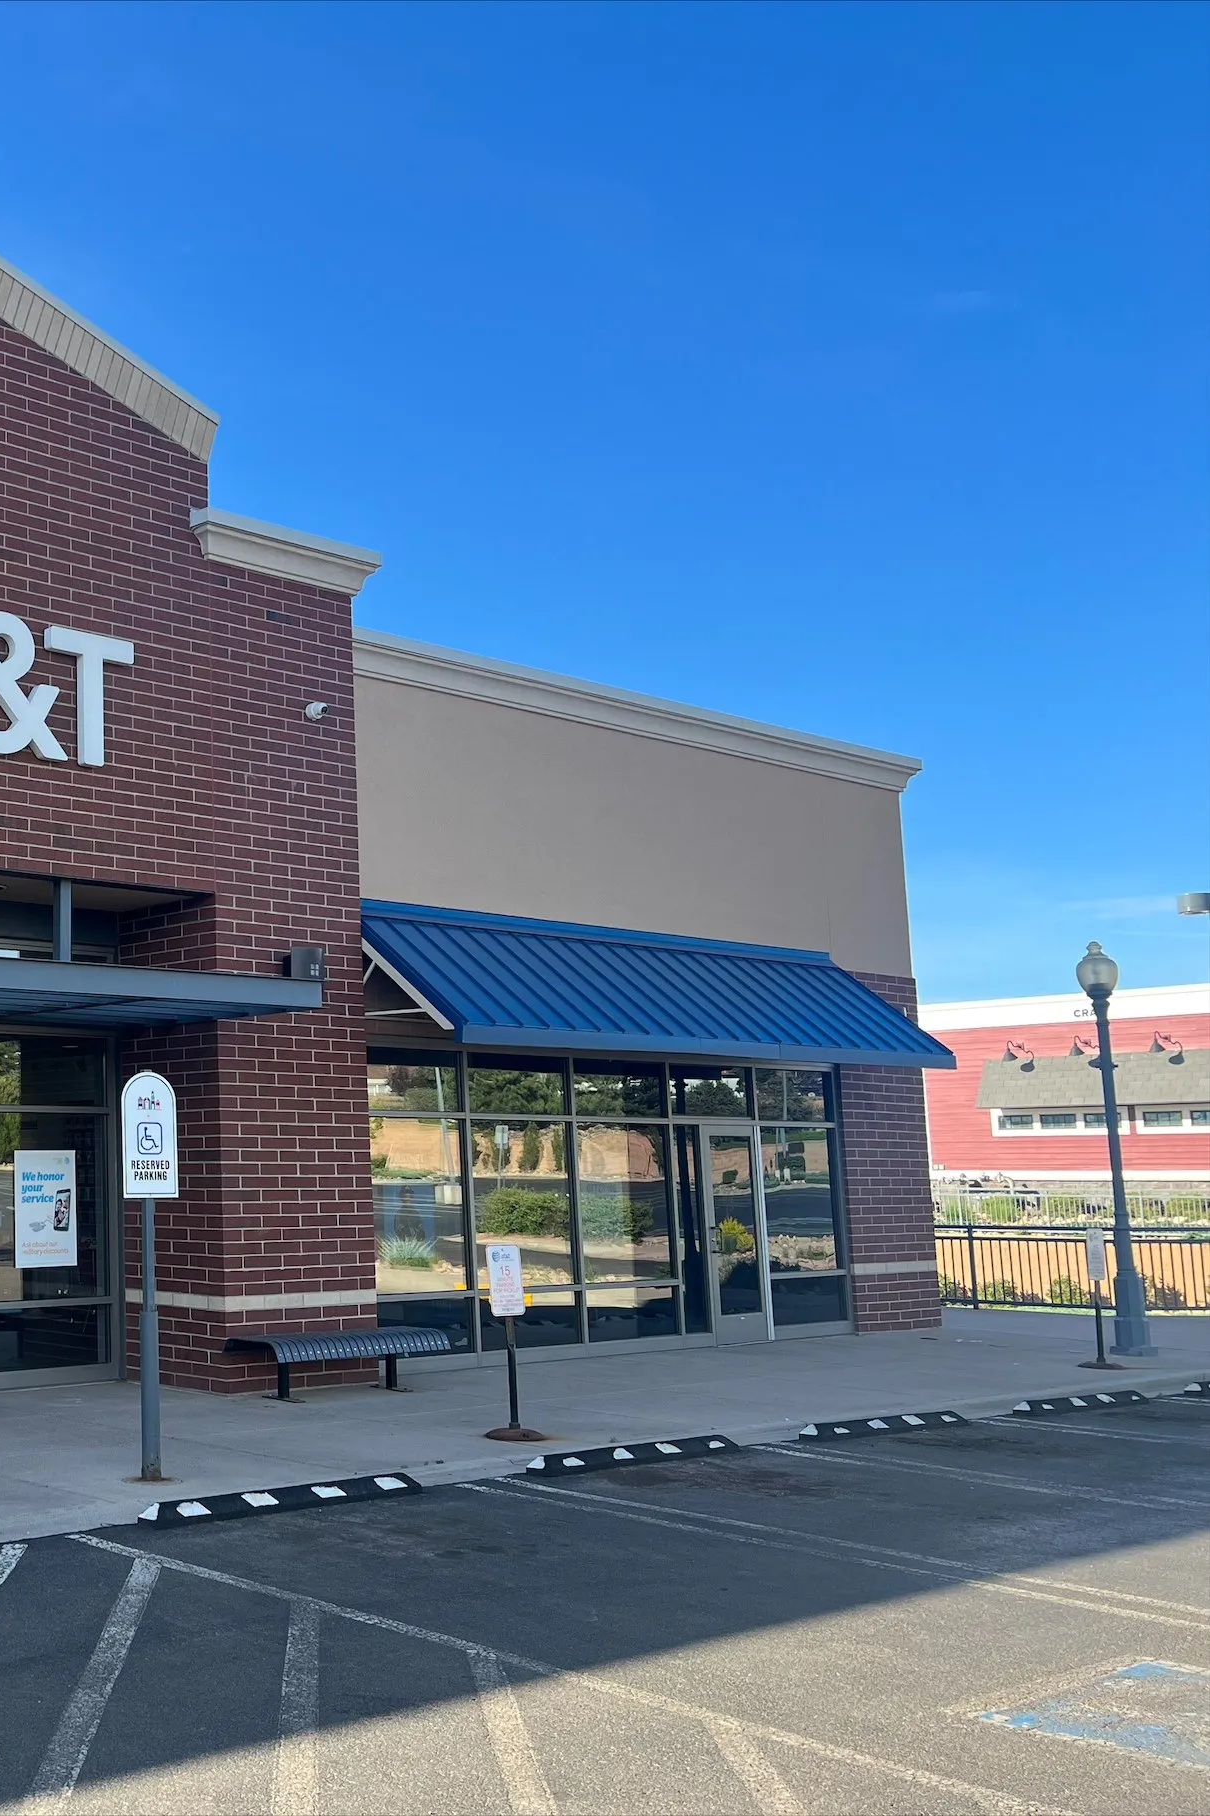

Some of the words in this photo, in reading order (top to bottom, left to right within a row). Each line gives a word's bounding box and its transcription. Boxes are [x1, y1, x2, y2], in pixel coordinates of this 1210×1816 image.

[131, 1159, 170, 1170] RESERVED
[21, 1171, 36, 1181] We
[37, 1171, 65, 1181] honor
[134, 1170, 167, 1181] PARKING
[21, 1184, 44, 1195] your
[21, 1194, 54, 1204] service
[499, 1265, 511, 1276] 15
